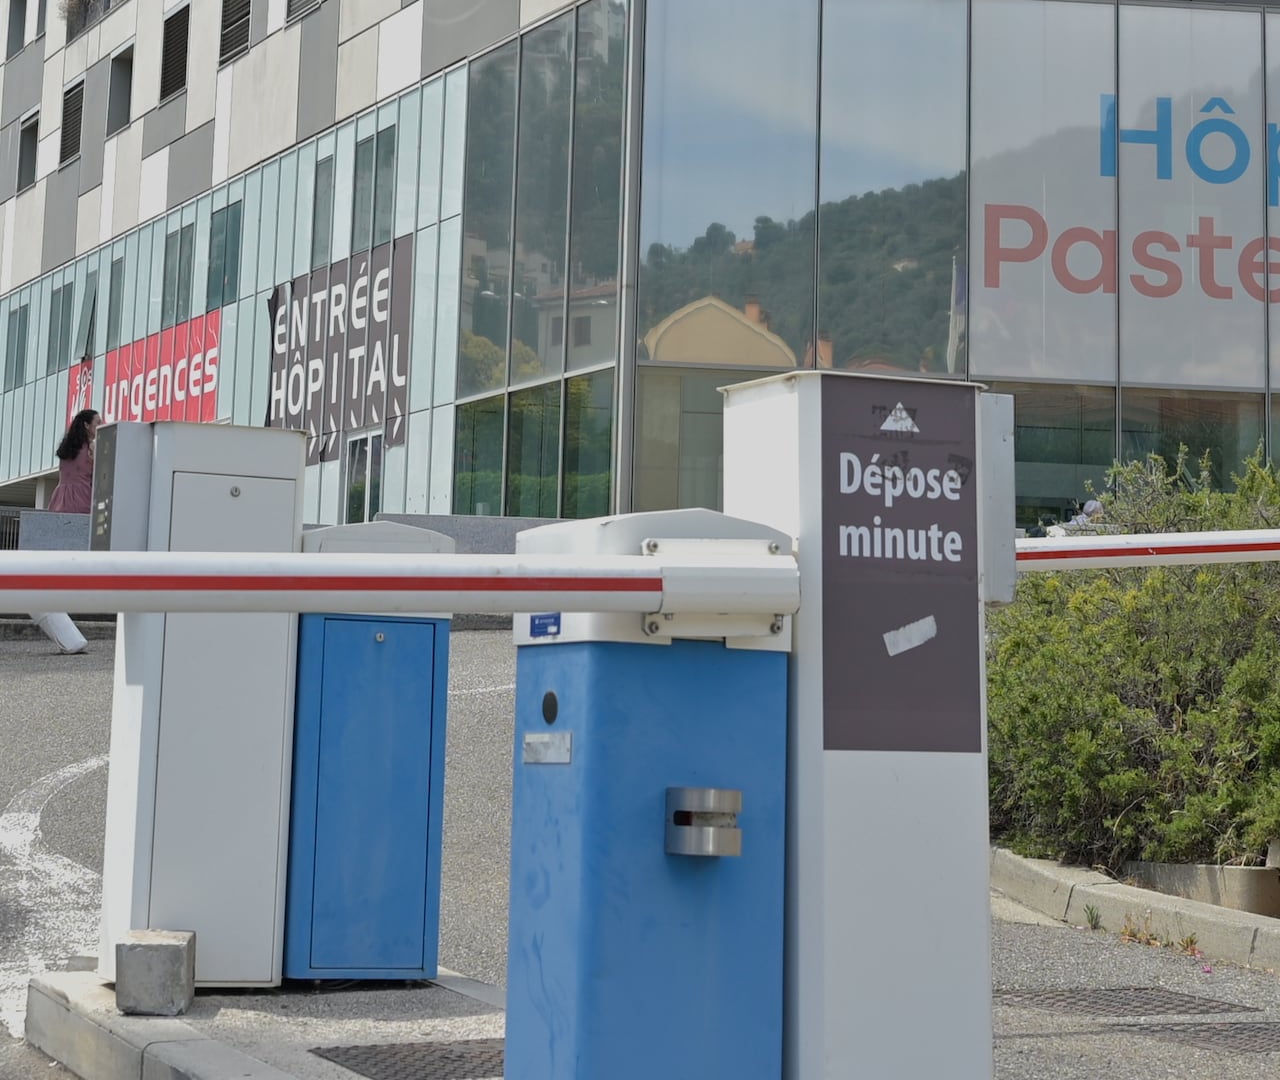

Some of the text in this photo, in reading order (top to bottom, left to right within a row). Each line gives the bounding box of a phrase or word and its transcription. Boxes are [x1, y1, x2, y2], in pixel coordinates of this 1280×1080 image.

[273, 261, 390, 355] ENTRÉE
[104, 346, 219, 424] urgences
[270, 333, 406, 421] HÔPITAL
[839, 451, 962, 508] Dépose
[838, 515, 963, 563] minute
